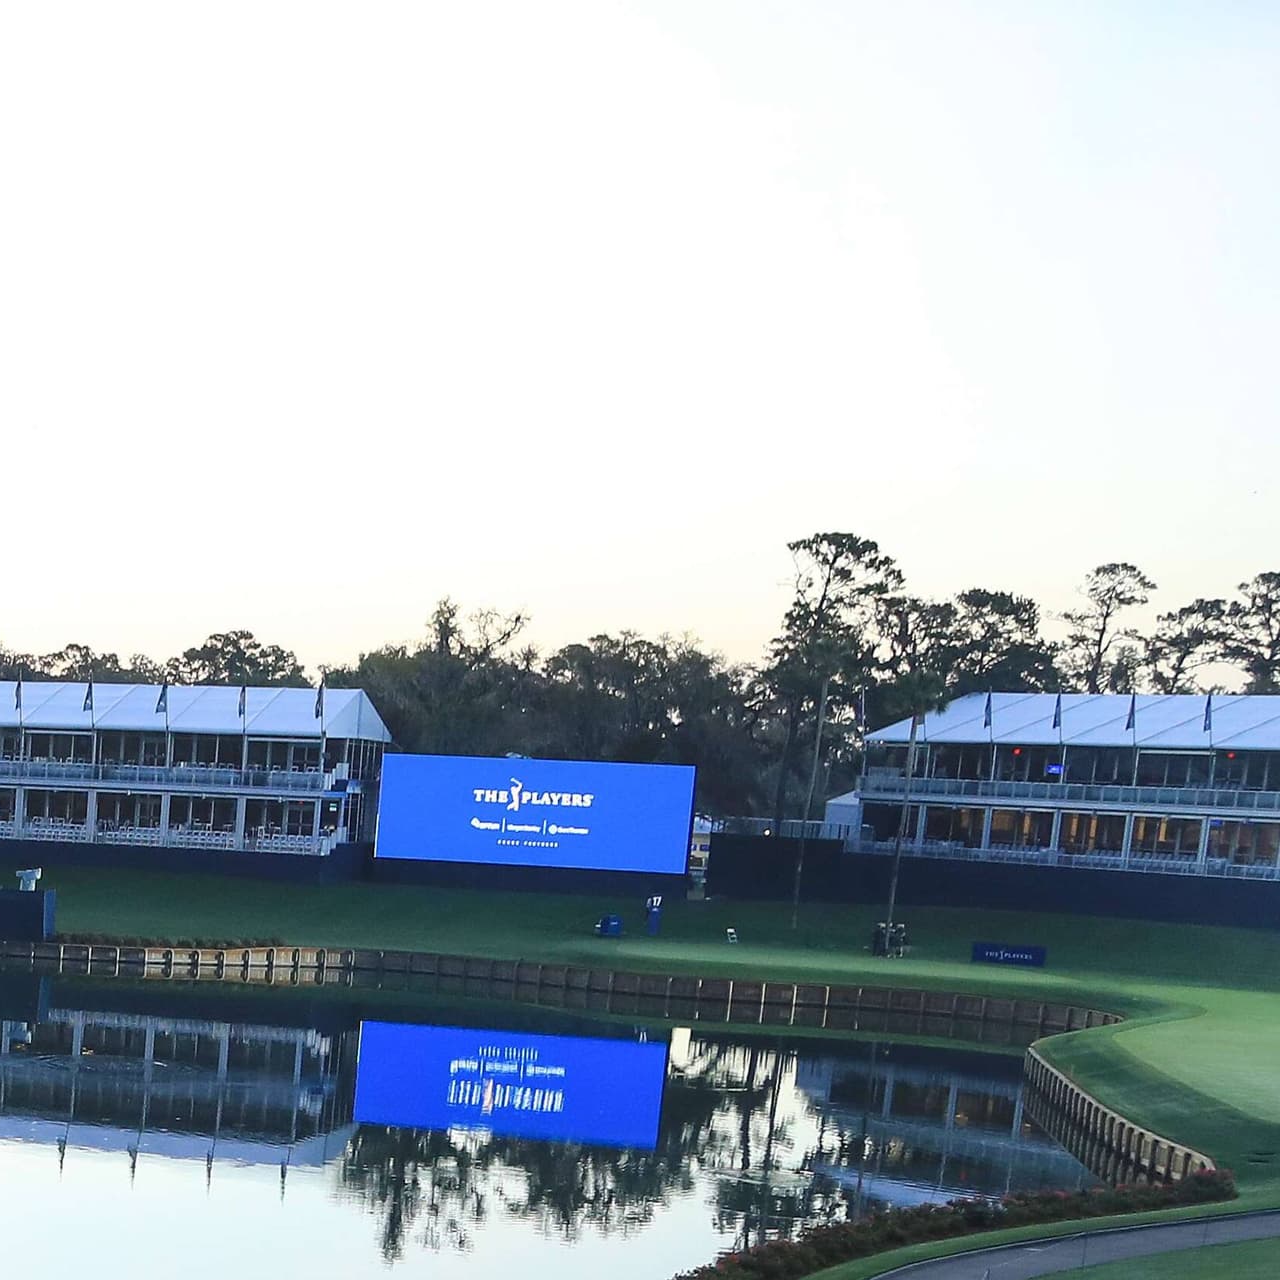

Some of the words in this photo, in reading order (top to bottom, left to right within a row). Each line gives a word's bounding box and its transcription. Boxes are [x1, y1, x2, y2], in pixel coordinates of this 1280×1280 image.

[473, 788, 509, 803] THE
[521, 791, 594, 807] PLAYERS
[652, 896, 662, 906] 17
